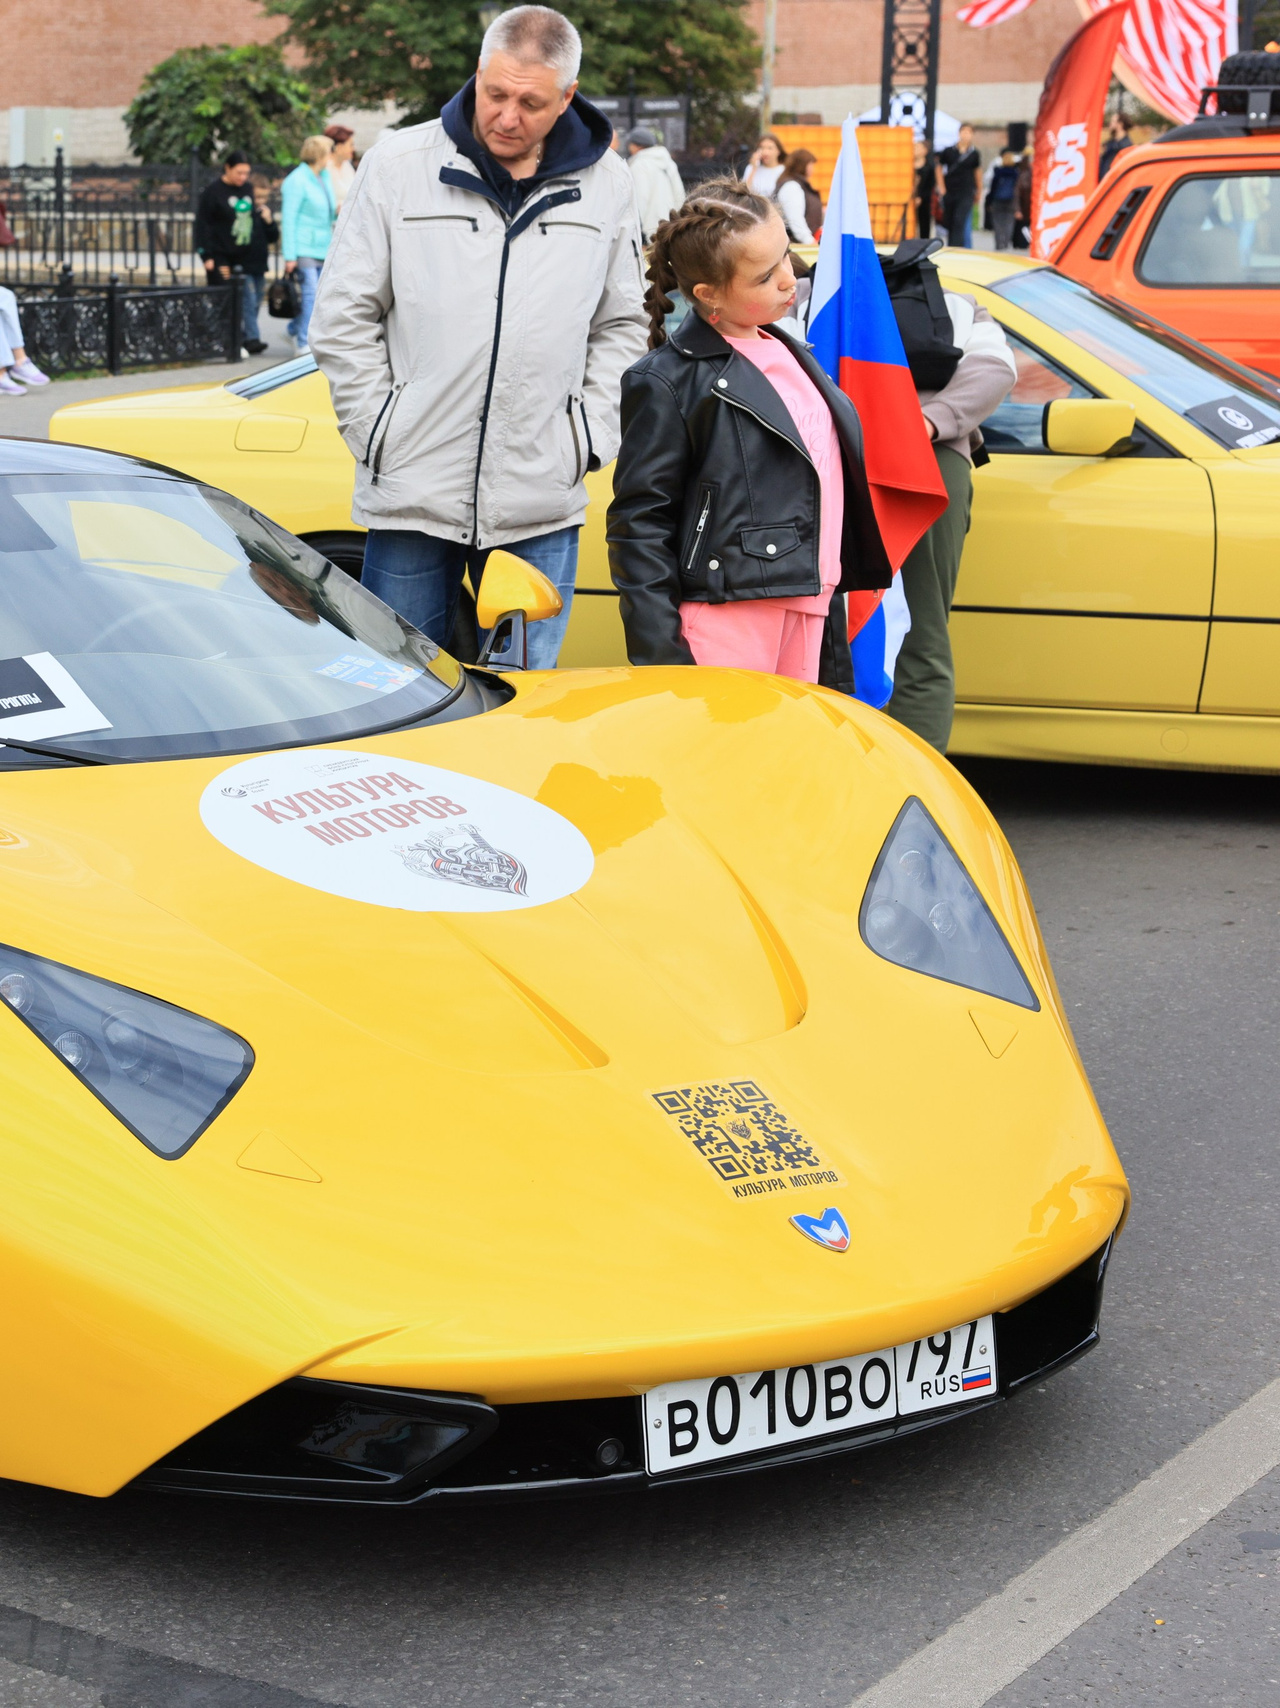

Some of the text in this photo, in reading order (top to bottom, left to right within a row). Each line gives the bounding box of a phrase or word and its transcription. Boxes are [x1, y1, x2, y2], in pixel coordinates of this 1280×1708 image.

[251, 771, 425, 825] КУЛЬТУРА
[303, 795, 468, 846] МОТОРОВ
[732, 1170, 839, 1198] КУЛЬТУРА МОТОРОВ
[921, 1374, 960, 1400] RUS
